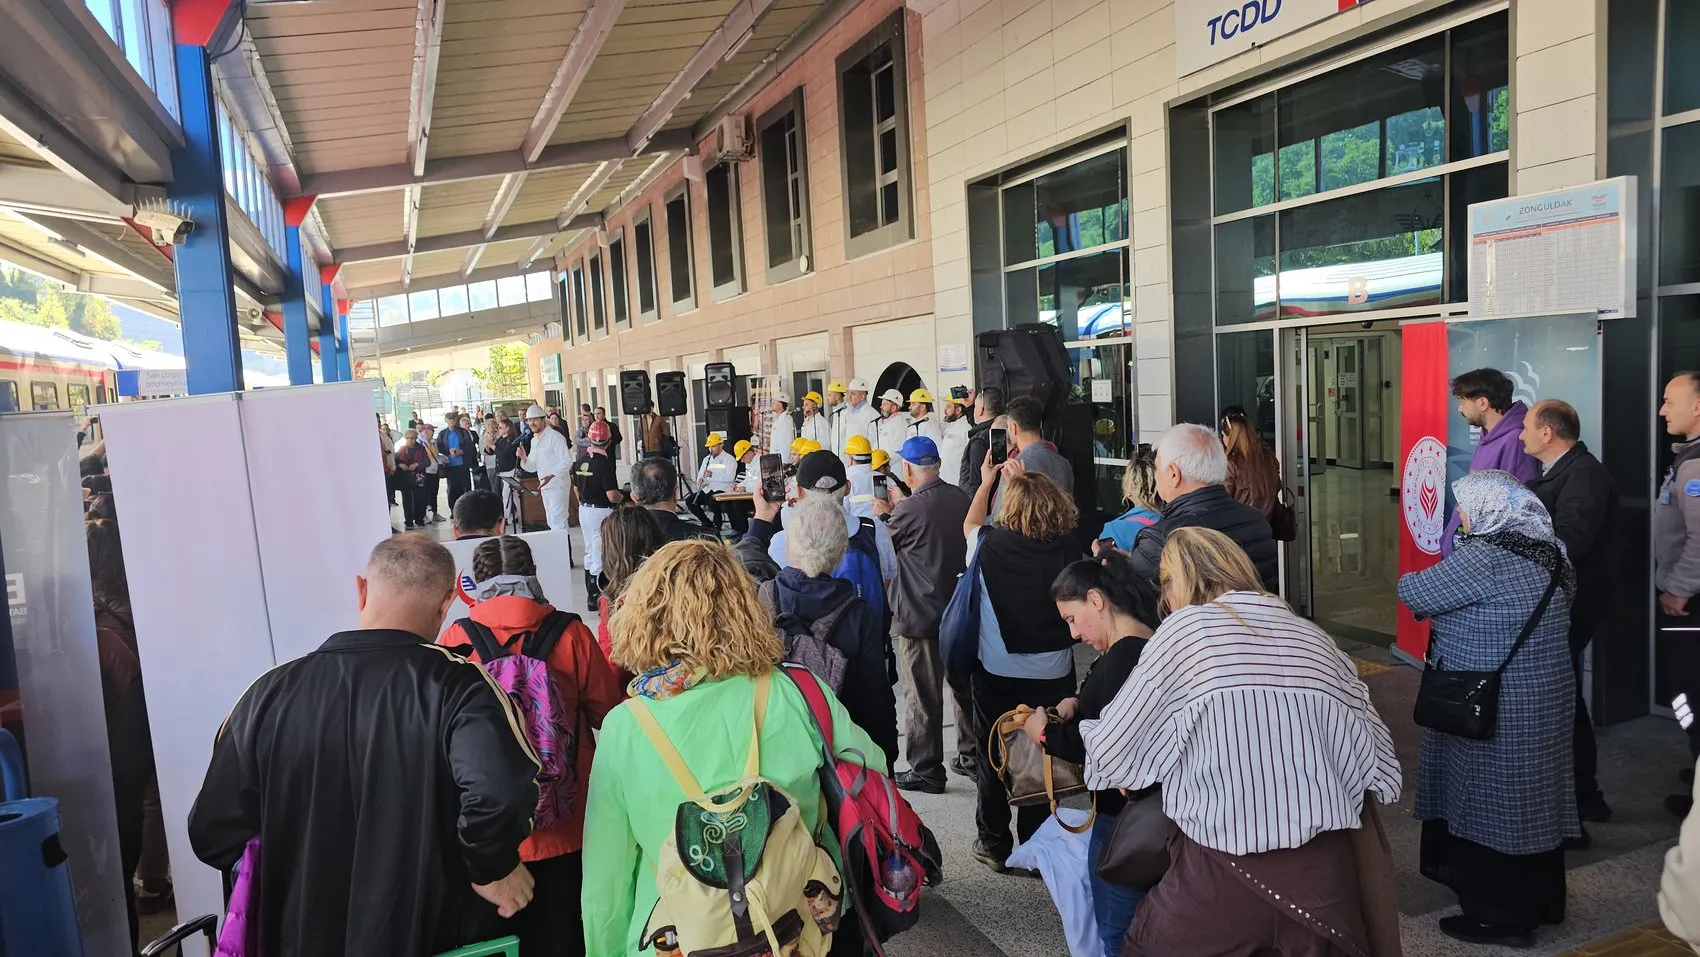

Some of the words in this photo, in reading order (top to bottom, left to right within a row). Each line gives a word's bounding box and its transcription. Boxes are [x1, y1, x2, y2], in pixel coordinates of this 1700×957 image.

[1207, 0, 1282, 46] TCDD
[1519, 198, 1573, 215] ZONGULDAK
[1348, 276, 1368, 304] B
